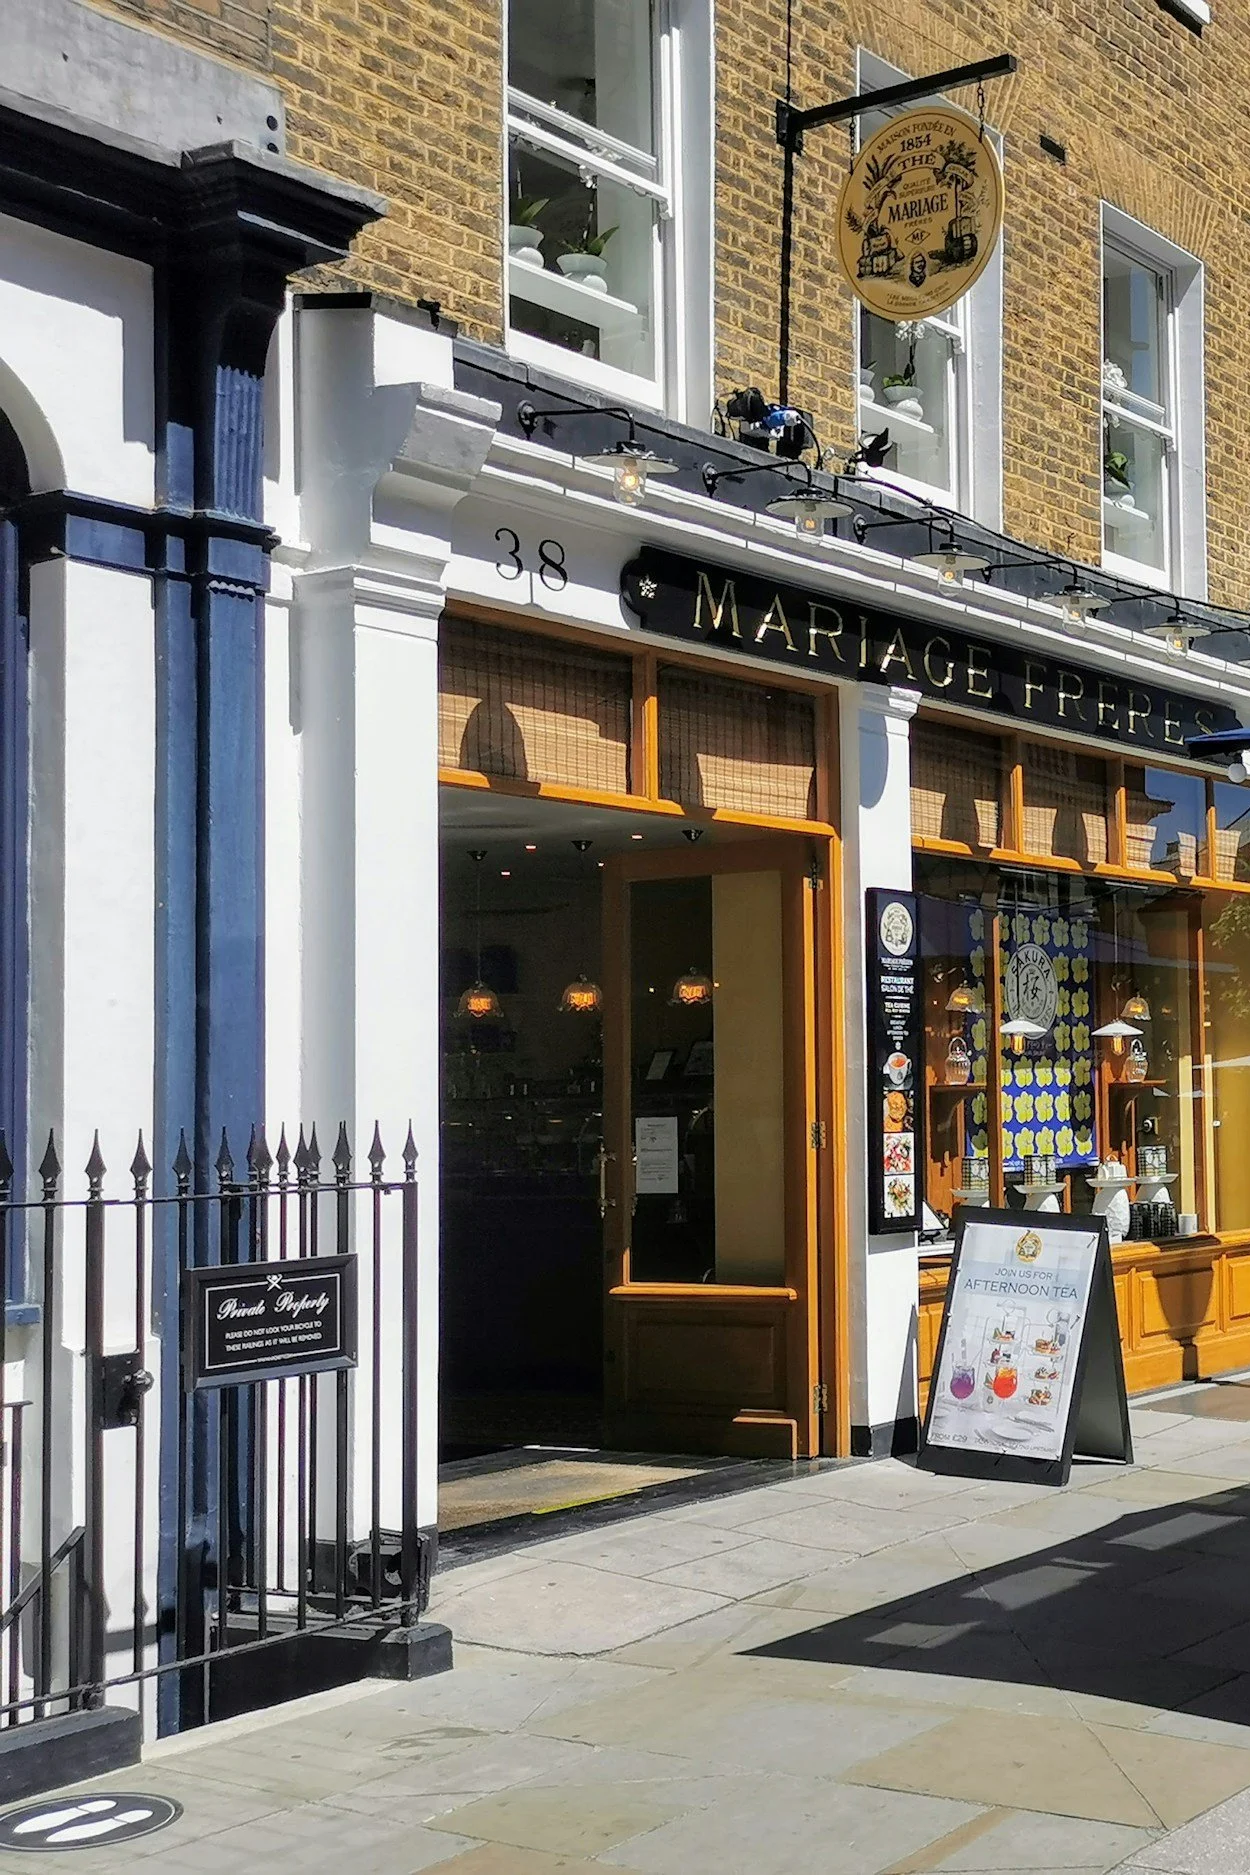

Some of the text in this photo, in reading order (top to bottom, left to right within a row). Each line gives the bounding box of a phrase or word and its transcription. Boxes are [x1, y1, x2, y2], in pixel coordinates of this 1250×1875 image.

[900, 133, 932, 153] 1854
[888, 192, 949, 223] MARIAGE
[495, 527, 568, 592] 38
[693, 570, 994, 699] MARIAGE
[1011, 949, 1051, 979] SAKURA
[995, 1267, 1053, 1281] JOIN US FOR
[964, 1278, 1078, 1299] AFTERNOON TEA
[217, 1291, 330, 1320] Private Property
[225, 1330, 243, 1340] PLEASE
[243, 1329, 253, 1338] DO
[253, 1328, 265, 1337] NOT
[280, 1324, 294, 1333] YOUR
[314, 1320, 322, 1328] TO
[279, 1337, 291, 1345] WILL
